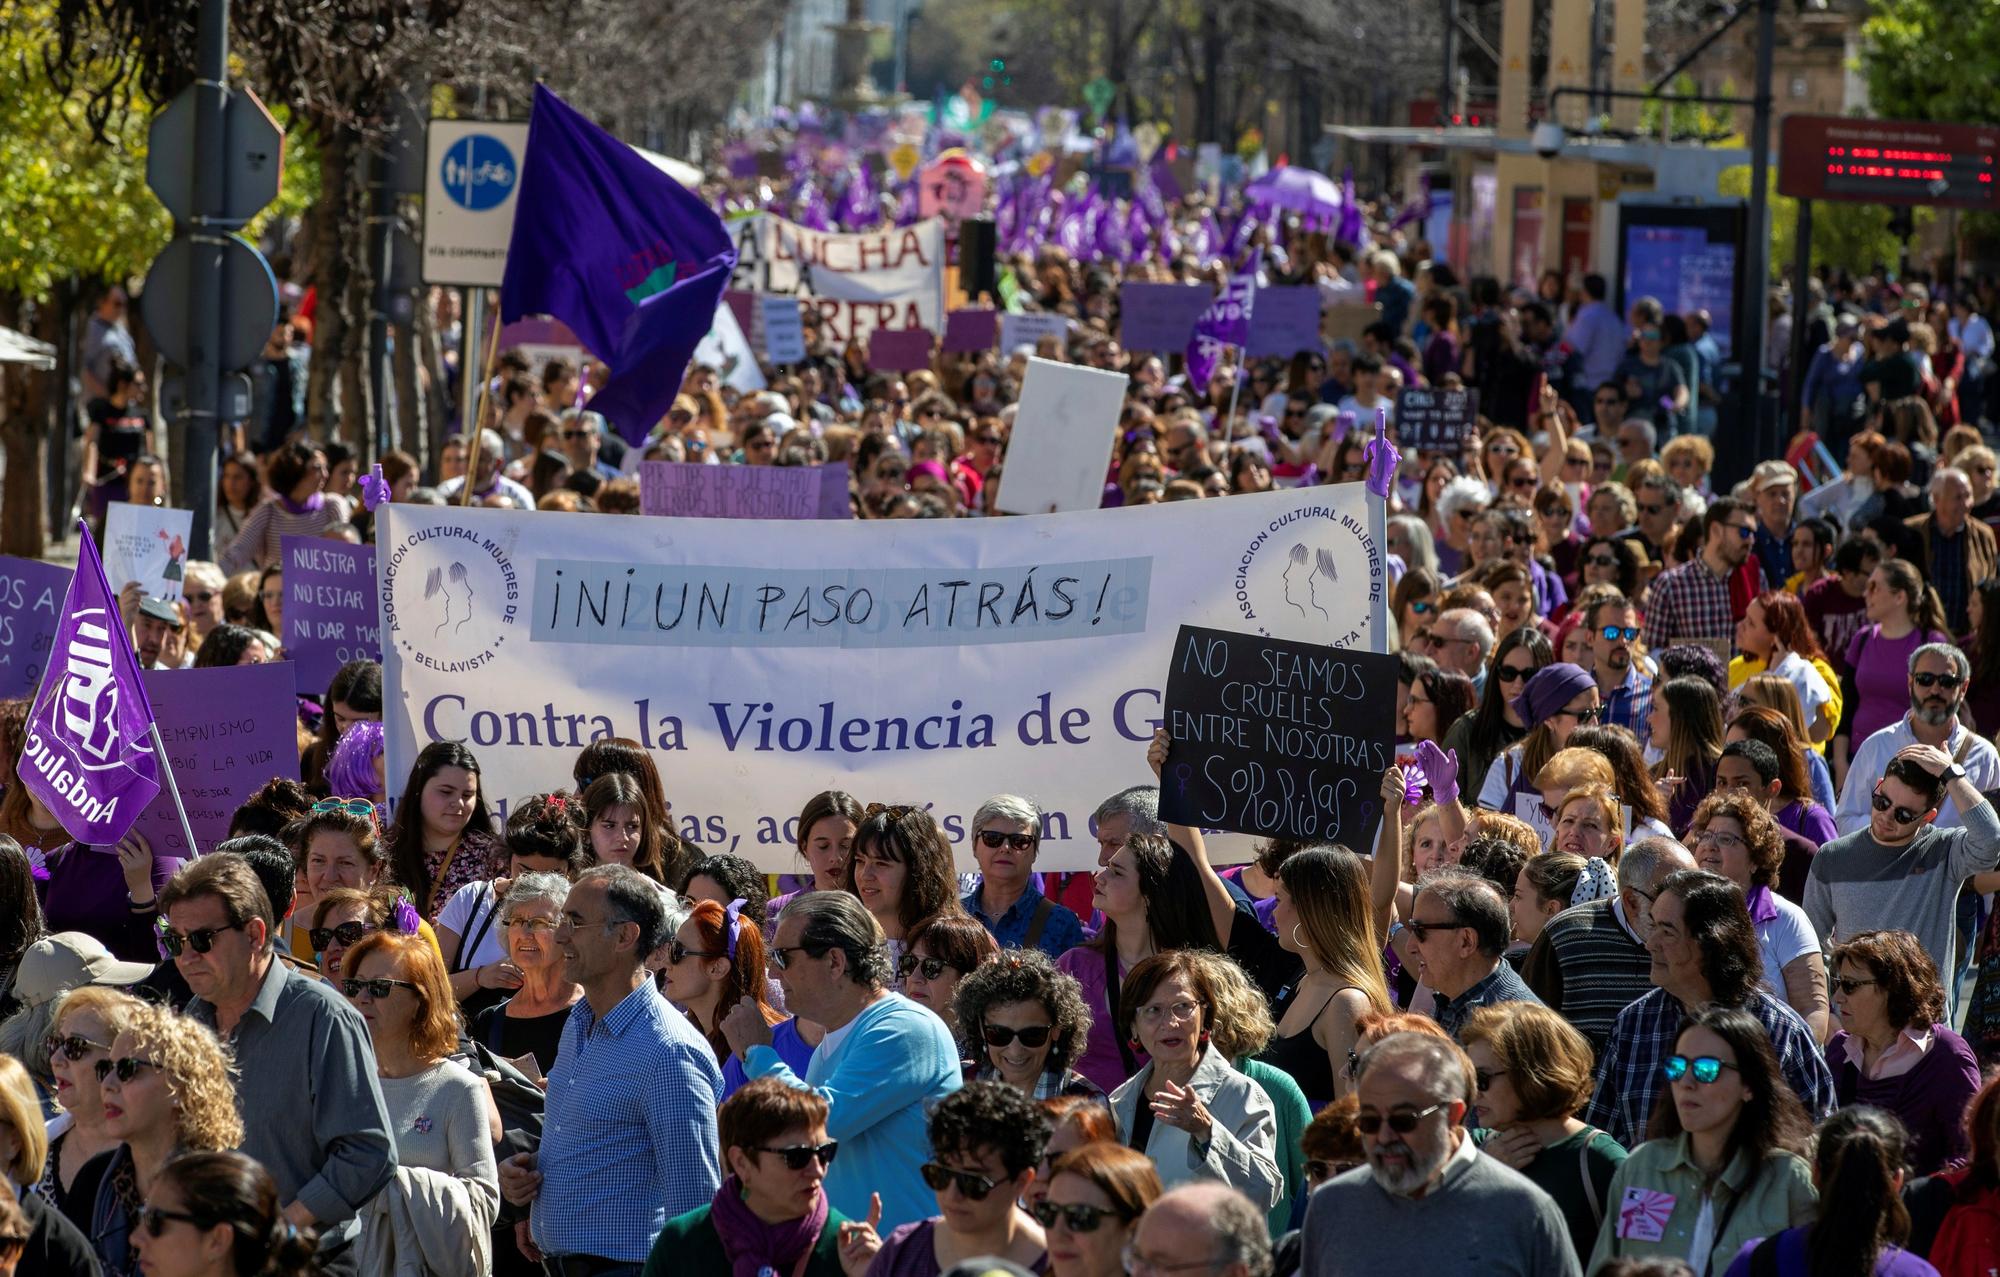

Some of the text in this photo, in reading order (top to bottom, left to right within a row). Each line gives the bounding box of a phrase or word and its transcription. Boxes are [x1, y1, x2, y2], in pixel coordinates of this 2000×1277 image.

[774, 222, 931, 273] LUCHA
[293, 548, 357, 574] NUESTRA
[383, 544, 408, 632] ASOCIACION
[408, 526, 480, 546] CULTURAL
[482, 539, 519, 600] MUJERES
[502, 604, 517, 625] DE
[1235, 506, 1381, 620] ASOCIACION CULTURAL MUJERES DE
[32, 586, 56, 616] A
[293, 583, 365, 611] NO ESTAR
[655, 579, 731, 631] UN
[755, 585, 873, 632] PASO
[902, 566, 1112, 637] ATRÁS!
[293, 619, 311, 638] NI
[317, 621, 345, 640] DAR
[415, 650, 496, 673] BELLAVISTA
[1183, 635, 1365, 701] NO SEAMOS
[423, 694, 616, 748] Contra
[634, 698, 689, 752] la
[708, 699, 997, 754] Violencia
[1017, 691, 1091, 746] de
[1221, 681, 1332, 730] CRUELES
[213, 756, 236, 772] LA
[246, 749, 274, 766] VIDA
[1172, 710, 1251, 749] ENTRE
[1265, 723, 1386, 773] NOSOTRAS
[192, 786, 233, 799] DEJAR
